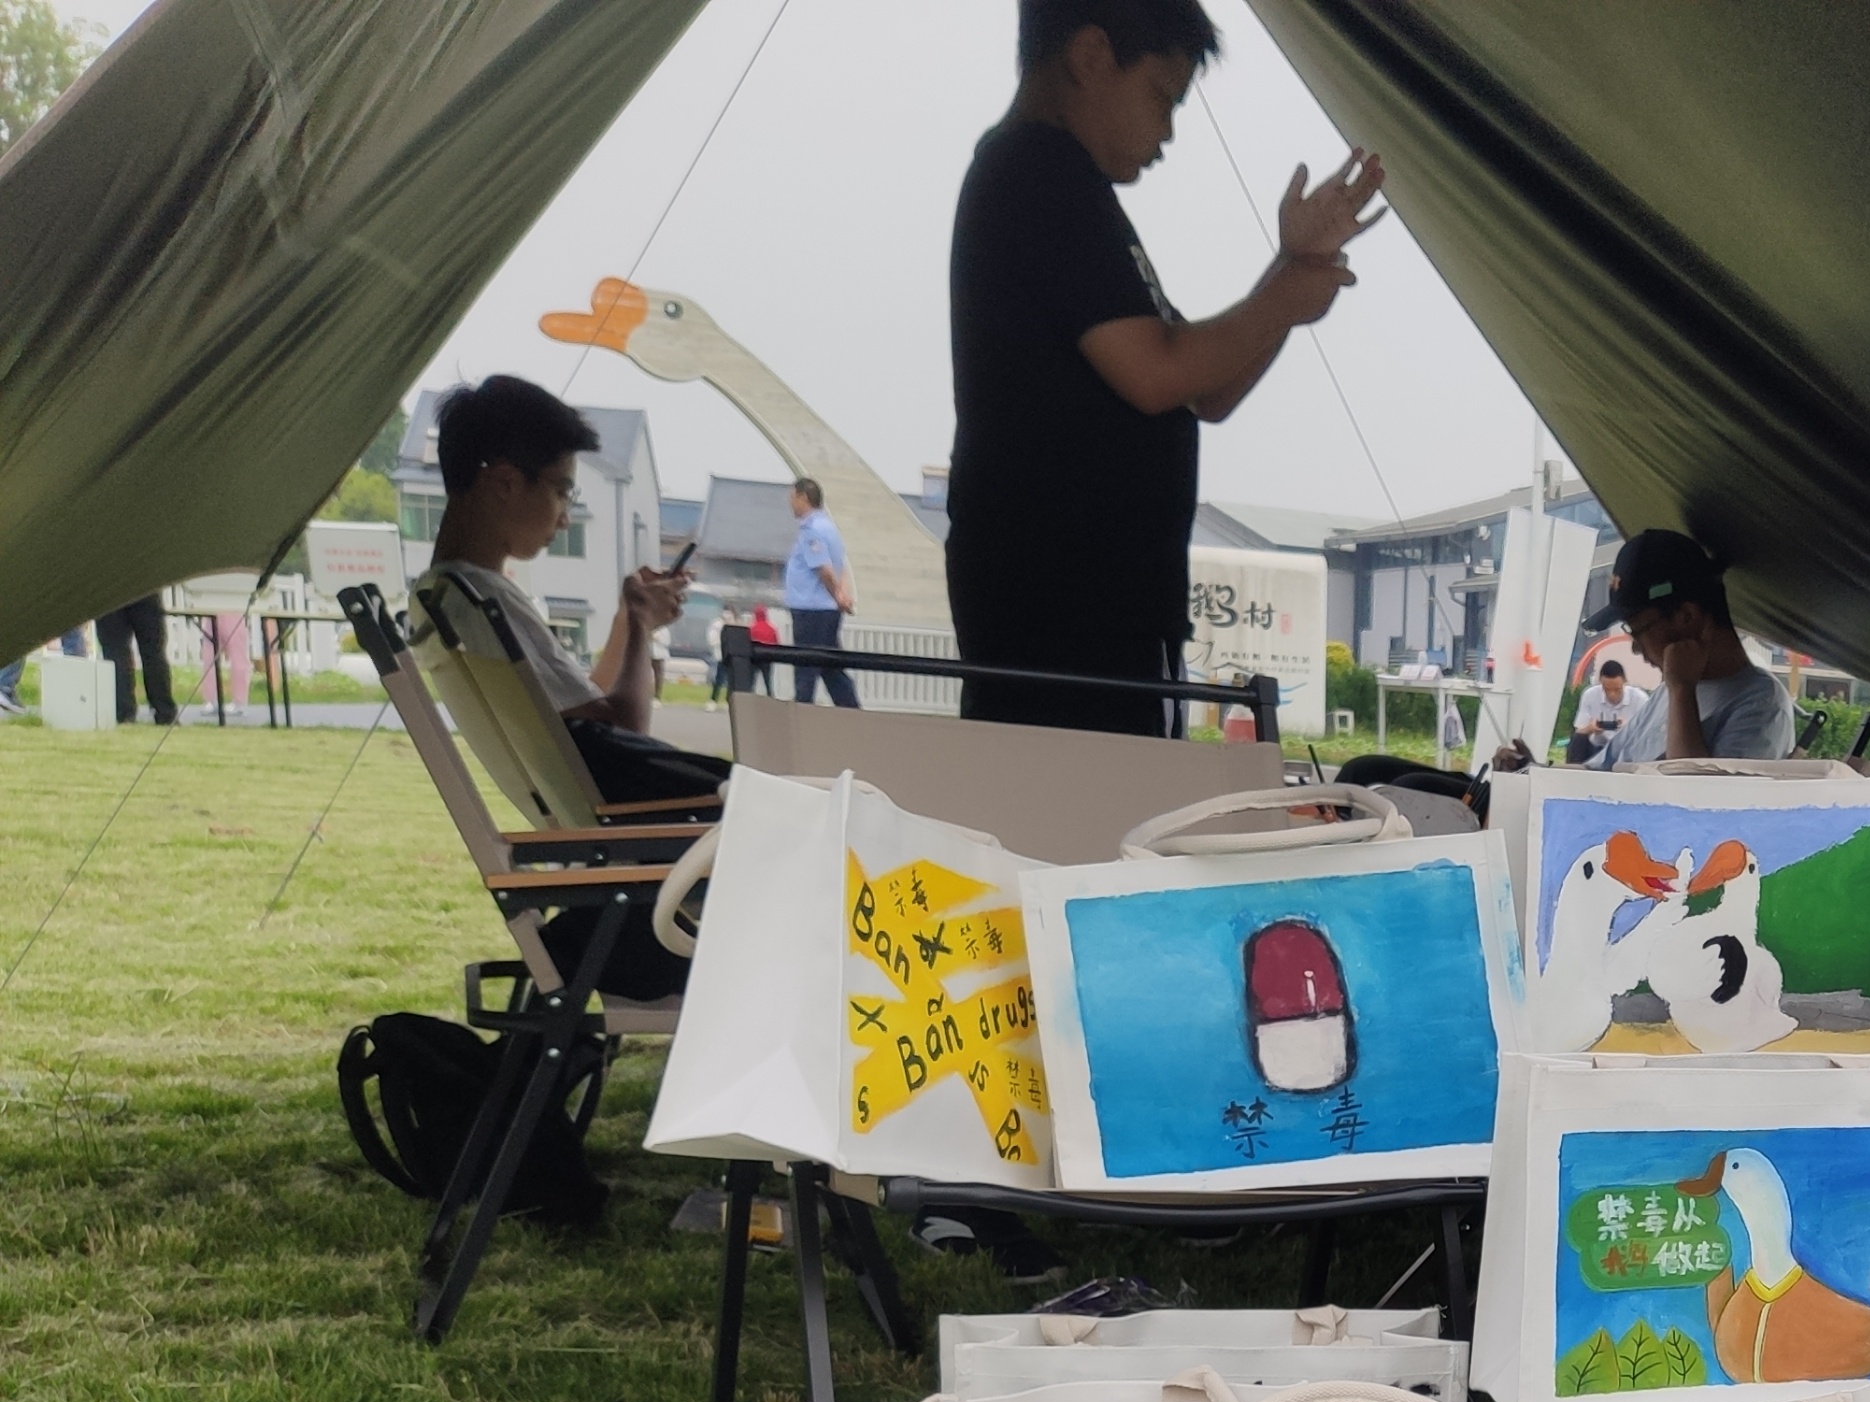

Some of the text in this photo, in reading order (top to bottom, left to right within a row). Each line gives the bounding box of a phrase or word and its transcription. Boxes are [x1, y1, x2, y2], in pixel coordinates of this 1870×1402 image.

[852, 881, 911, 985] Ban
[960, 917, 1004, 960] 禁毒
[897, 1014, 964, 1093] Ban
[1222, 1085, 1370, 1159] 禁毒
[1597, 1190, 1706, 1241] 禁毒从
